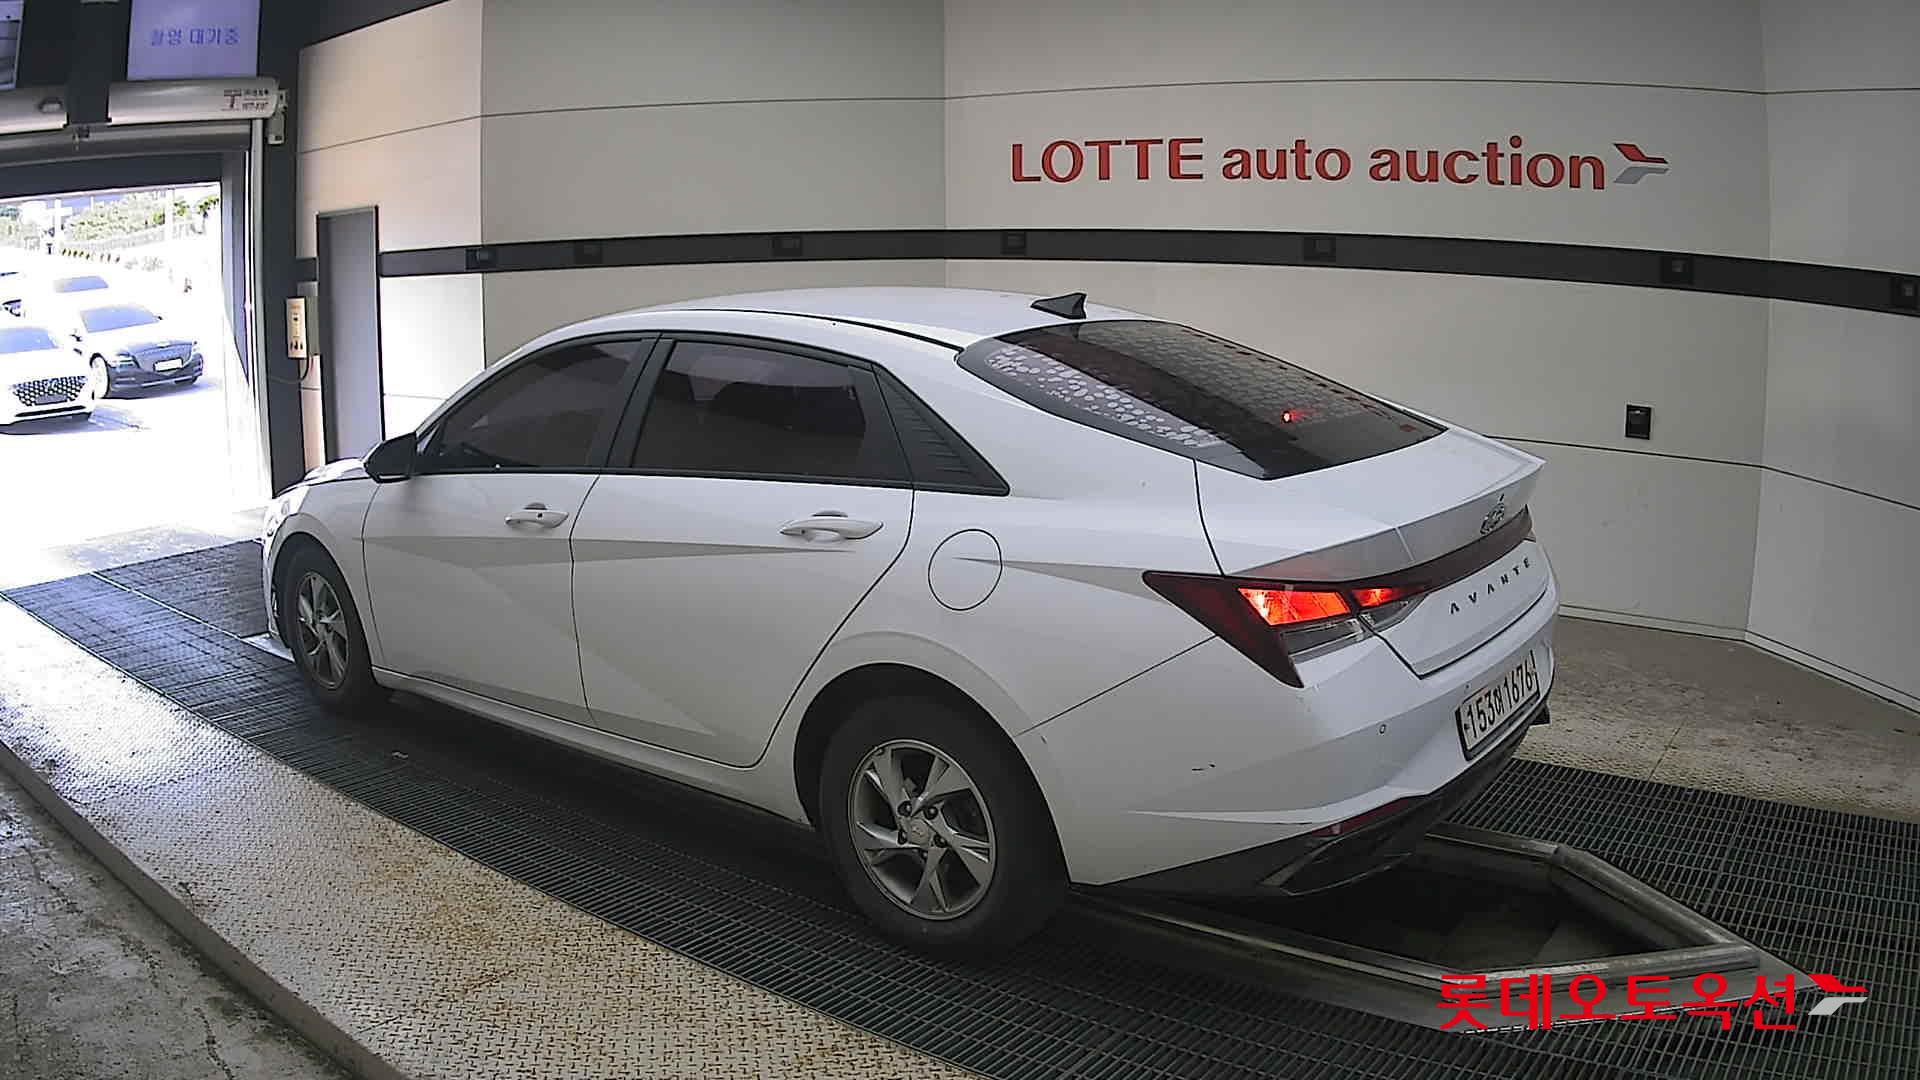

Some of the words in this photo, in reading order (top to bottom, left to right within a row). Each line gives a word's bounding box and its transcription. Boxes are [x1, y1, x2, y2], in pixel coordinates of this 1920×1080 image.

[1011, 138, 1204, 182] LOTTE
[1223, 139, 1352, 181] auto
[1369, 135, 1605, 190] auction
[1450, 557, 1530, 614] AVANTE
